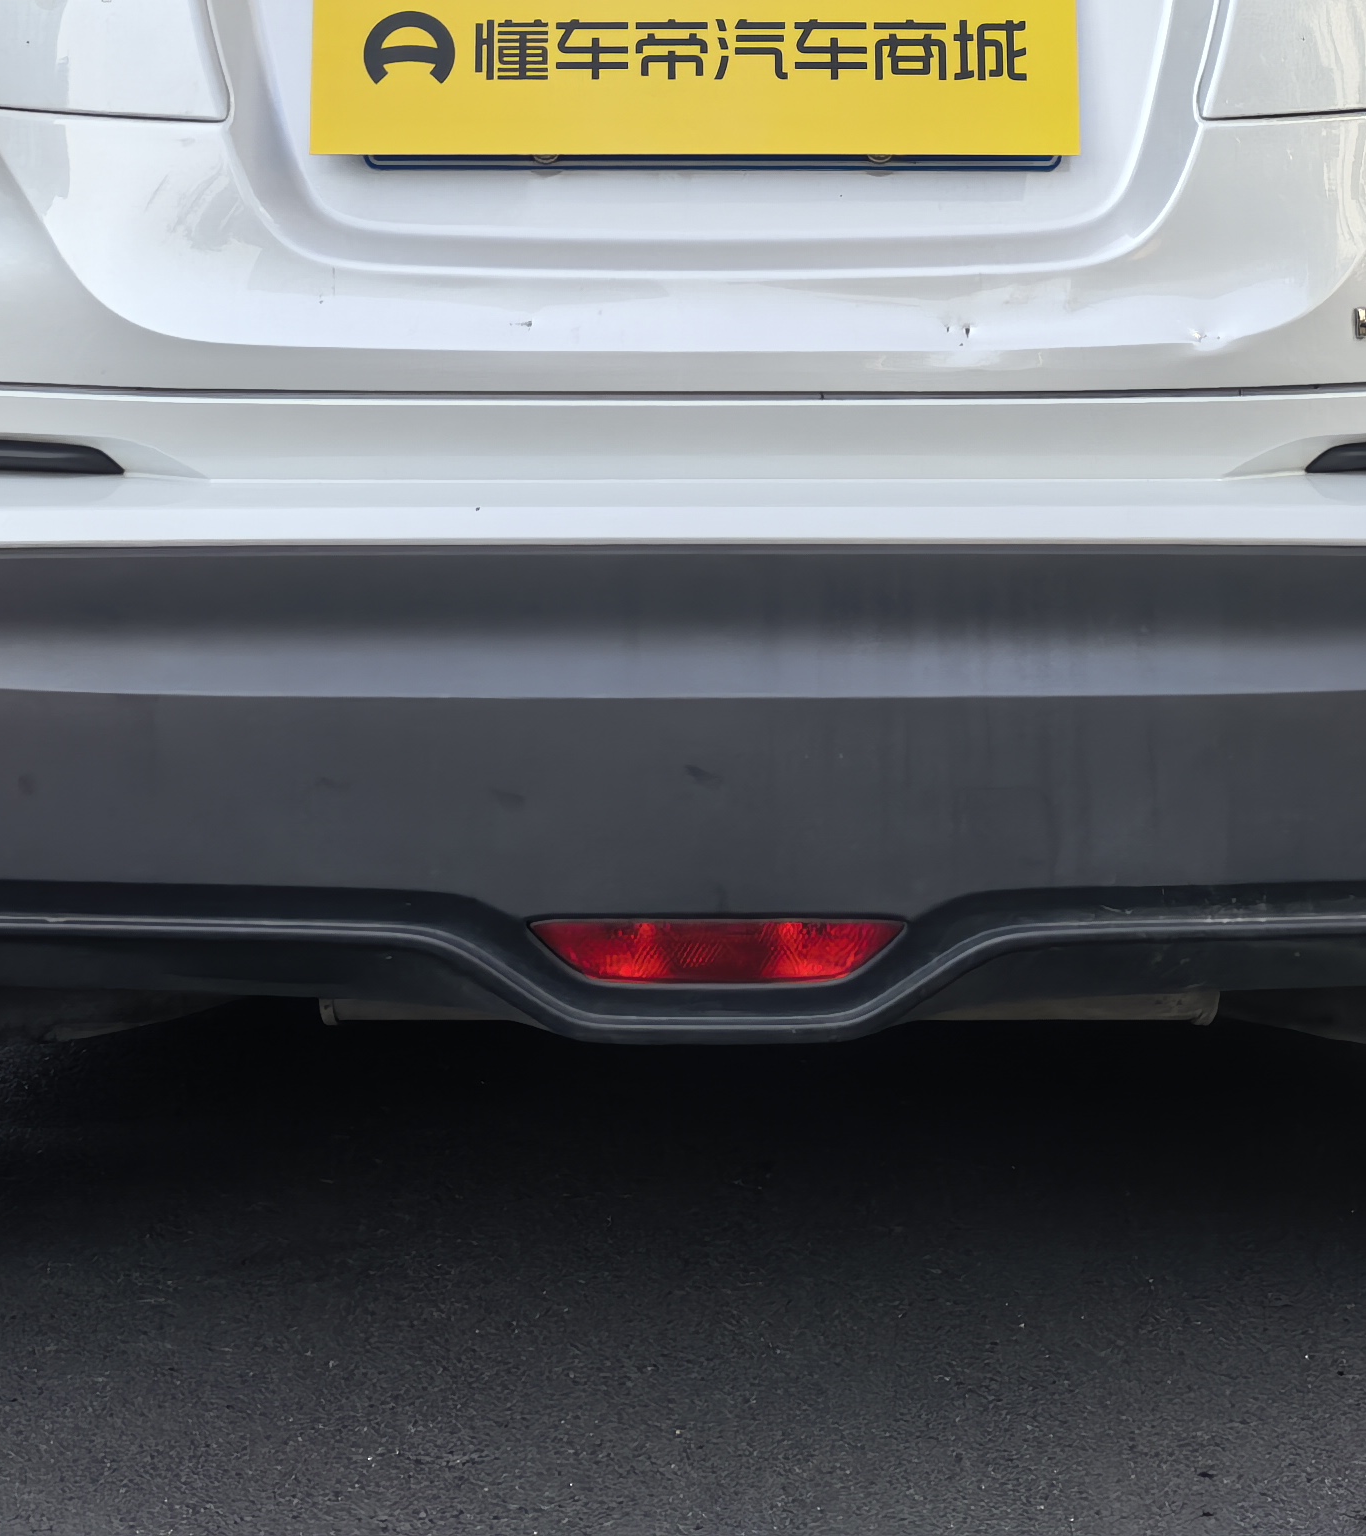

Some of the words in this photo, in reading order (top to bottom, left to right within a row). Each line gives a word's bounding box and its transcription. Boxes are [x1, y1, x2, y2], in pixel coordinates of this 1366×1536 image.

[473, 18, 1028, 81] 懂车帝汽车商城
